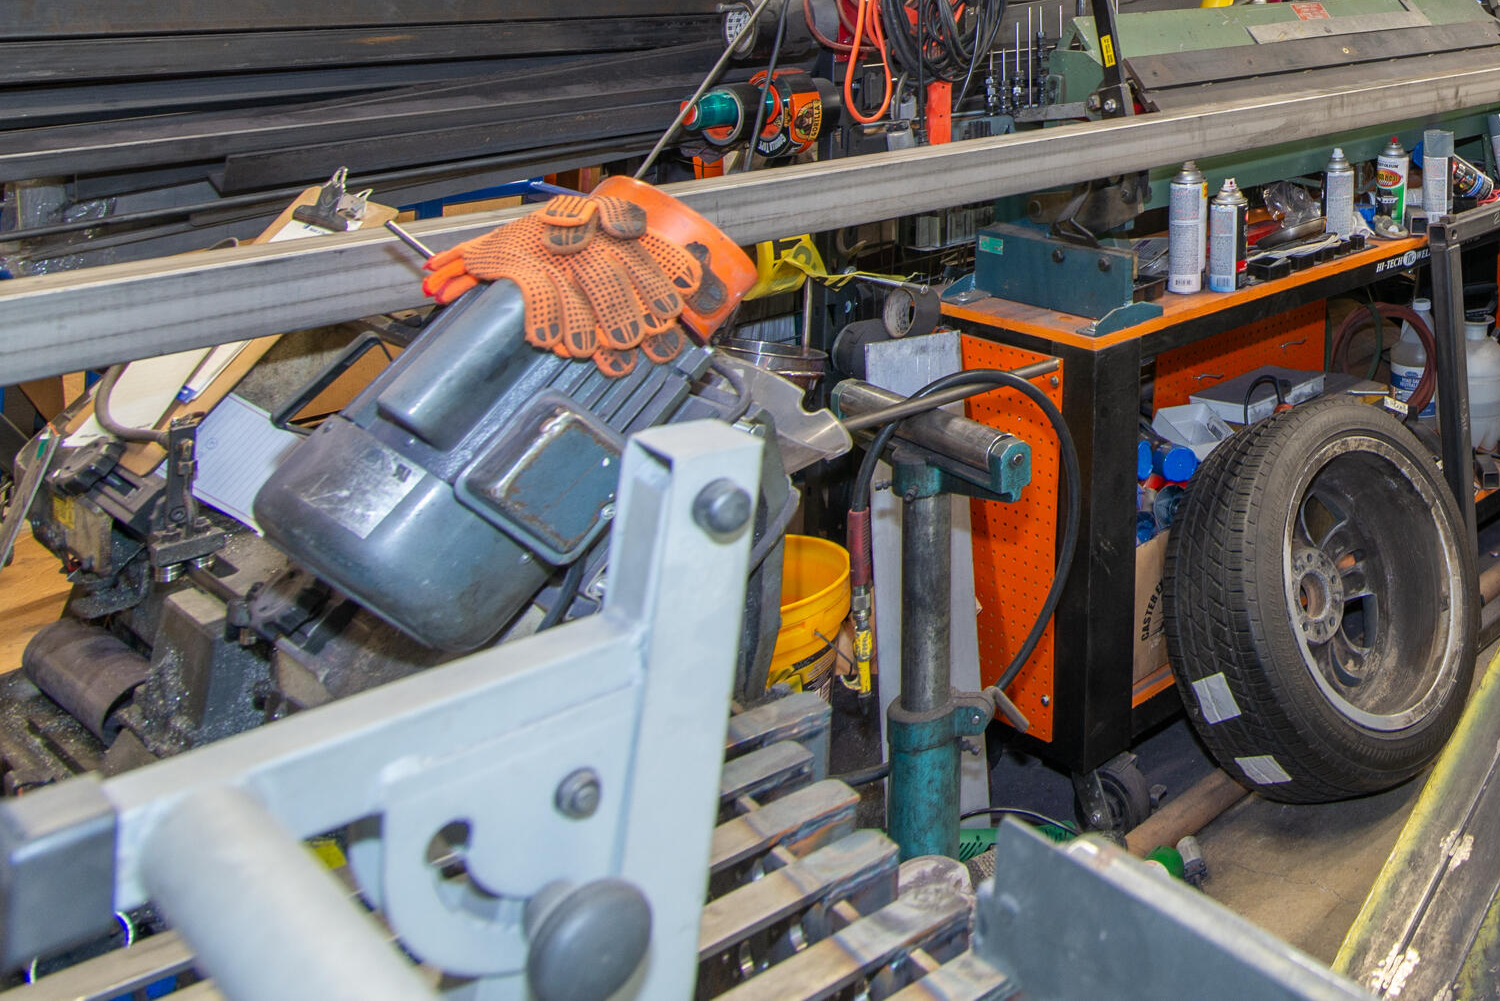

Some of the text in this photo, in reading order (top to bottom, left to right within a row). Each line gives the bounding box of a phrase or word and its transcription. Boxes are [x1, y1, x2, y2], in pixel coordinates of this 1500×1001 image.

[811, 103, 822, 137] GORILLA
[1376, 256, 1403, 273] HI-TECH
[1141, 594, 1158, 641] CASTER
